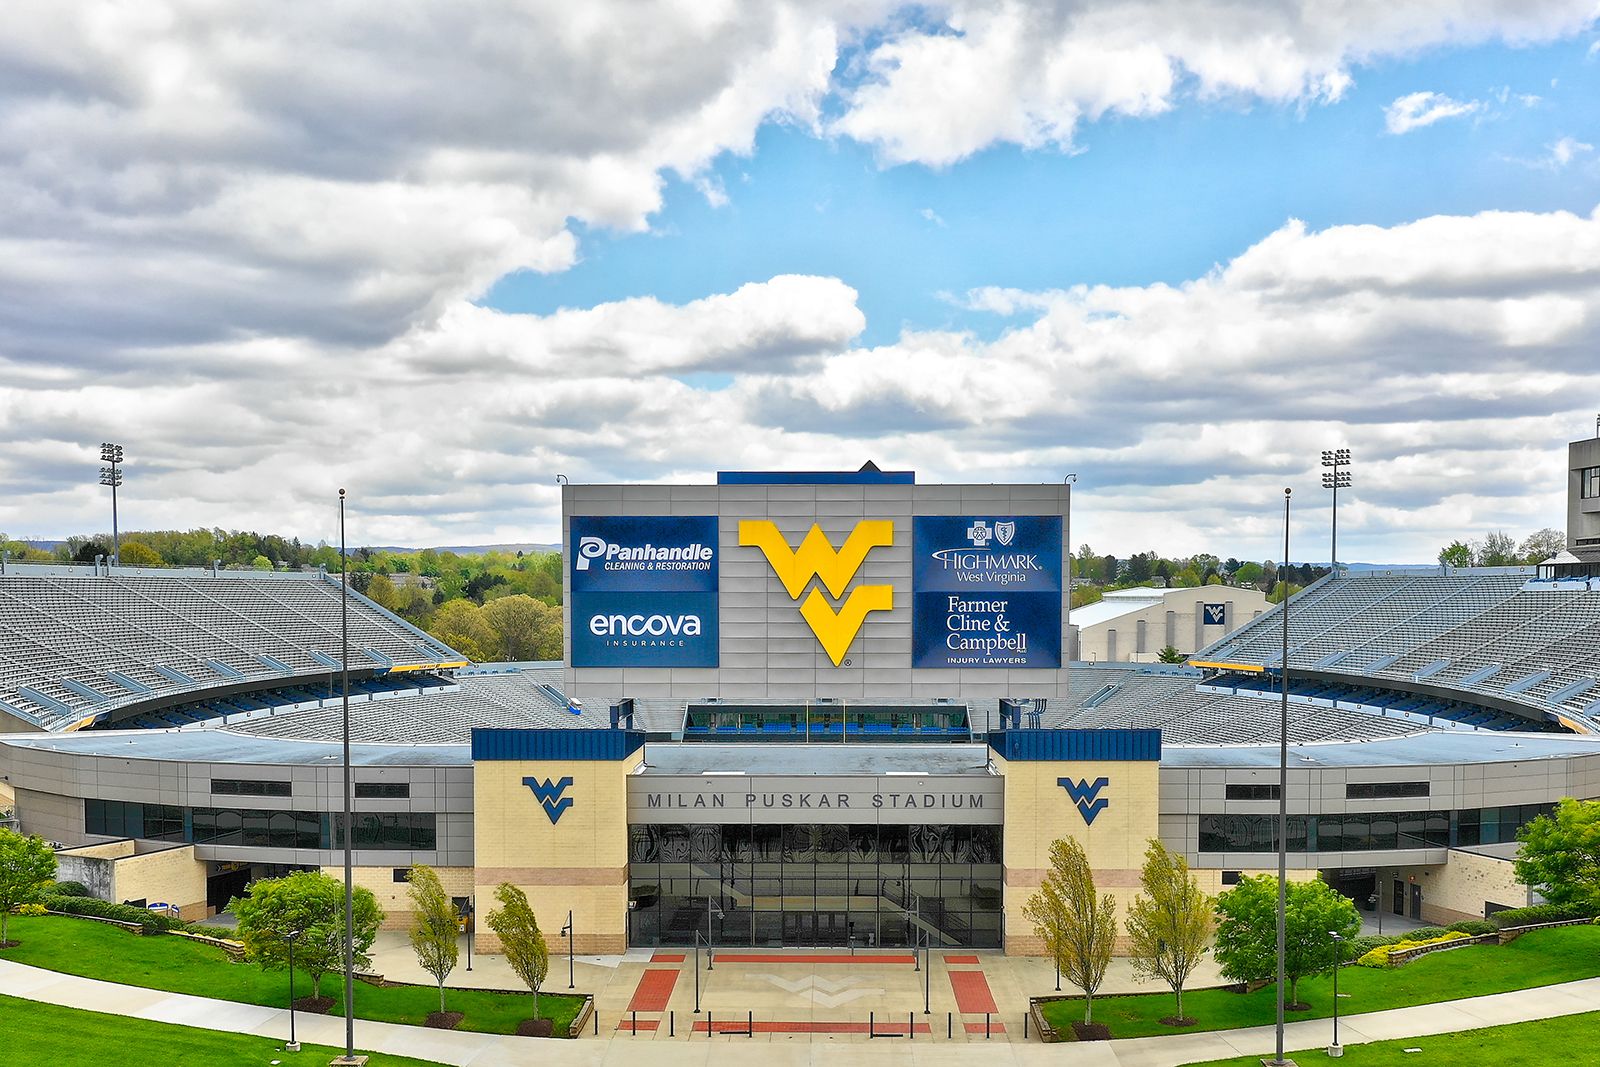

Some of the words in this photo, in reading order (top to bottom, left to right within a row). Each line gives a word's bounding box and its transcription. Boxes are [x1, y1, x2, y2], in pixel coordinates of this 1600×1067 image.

[605, 543, 713, 561] Panhandle
[934, 549, 1039, 571] HIGHMARK
[604, 561, 645, 571] CLEANING
[646, 561, 654, 571] &
[655, 561, 711, 571] RESTORATION
[956, 571, 984, 582] West
[986, 570, 1026, 585] Virginia
[947, 595, 1008, 613] Farmer
[589, 614, 701, 636] encova
[946, 614, 991, 631] Cline
[993, 613, 1011, 632] &
[946, 632, 1026, 656] Campbell
[647, 793, 725, 808] MILAN
[745, 793, 850, 808] PUSKAR
[871, 794, 983, 808] STADIUM
